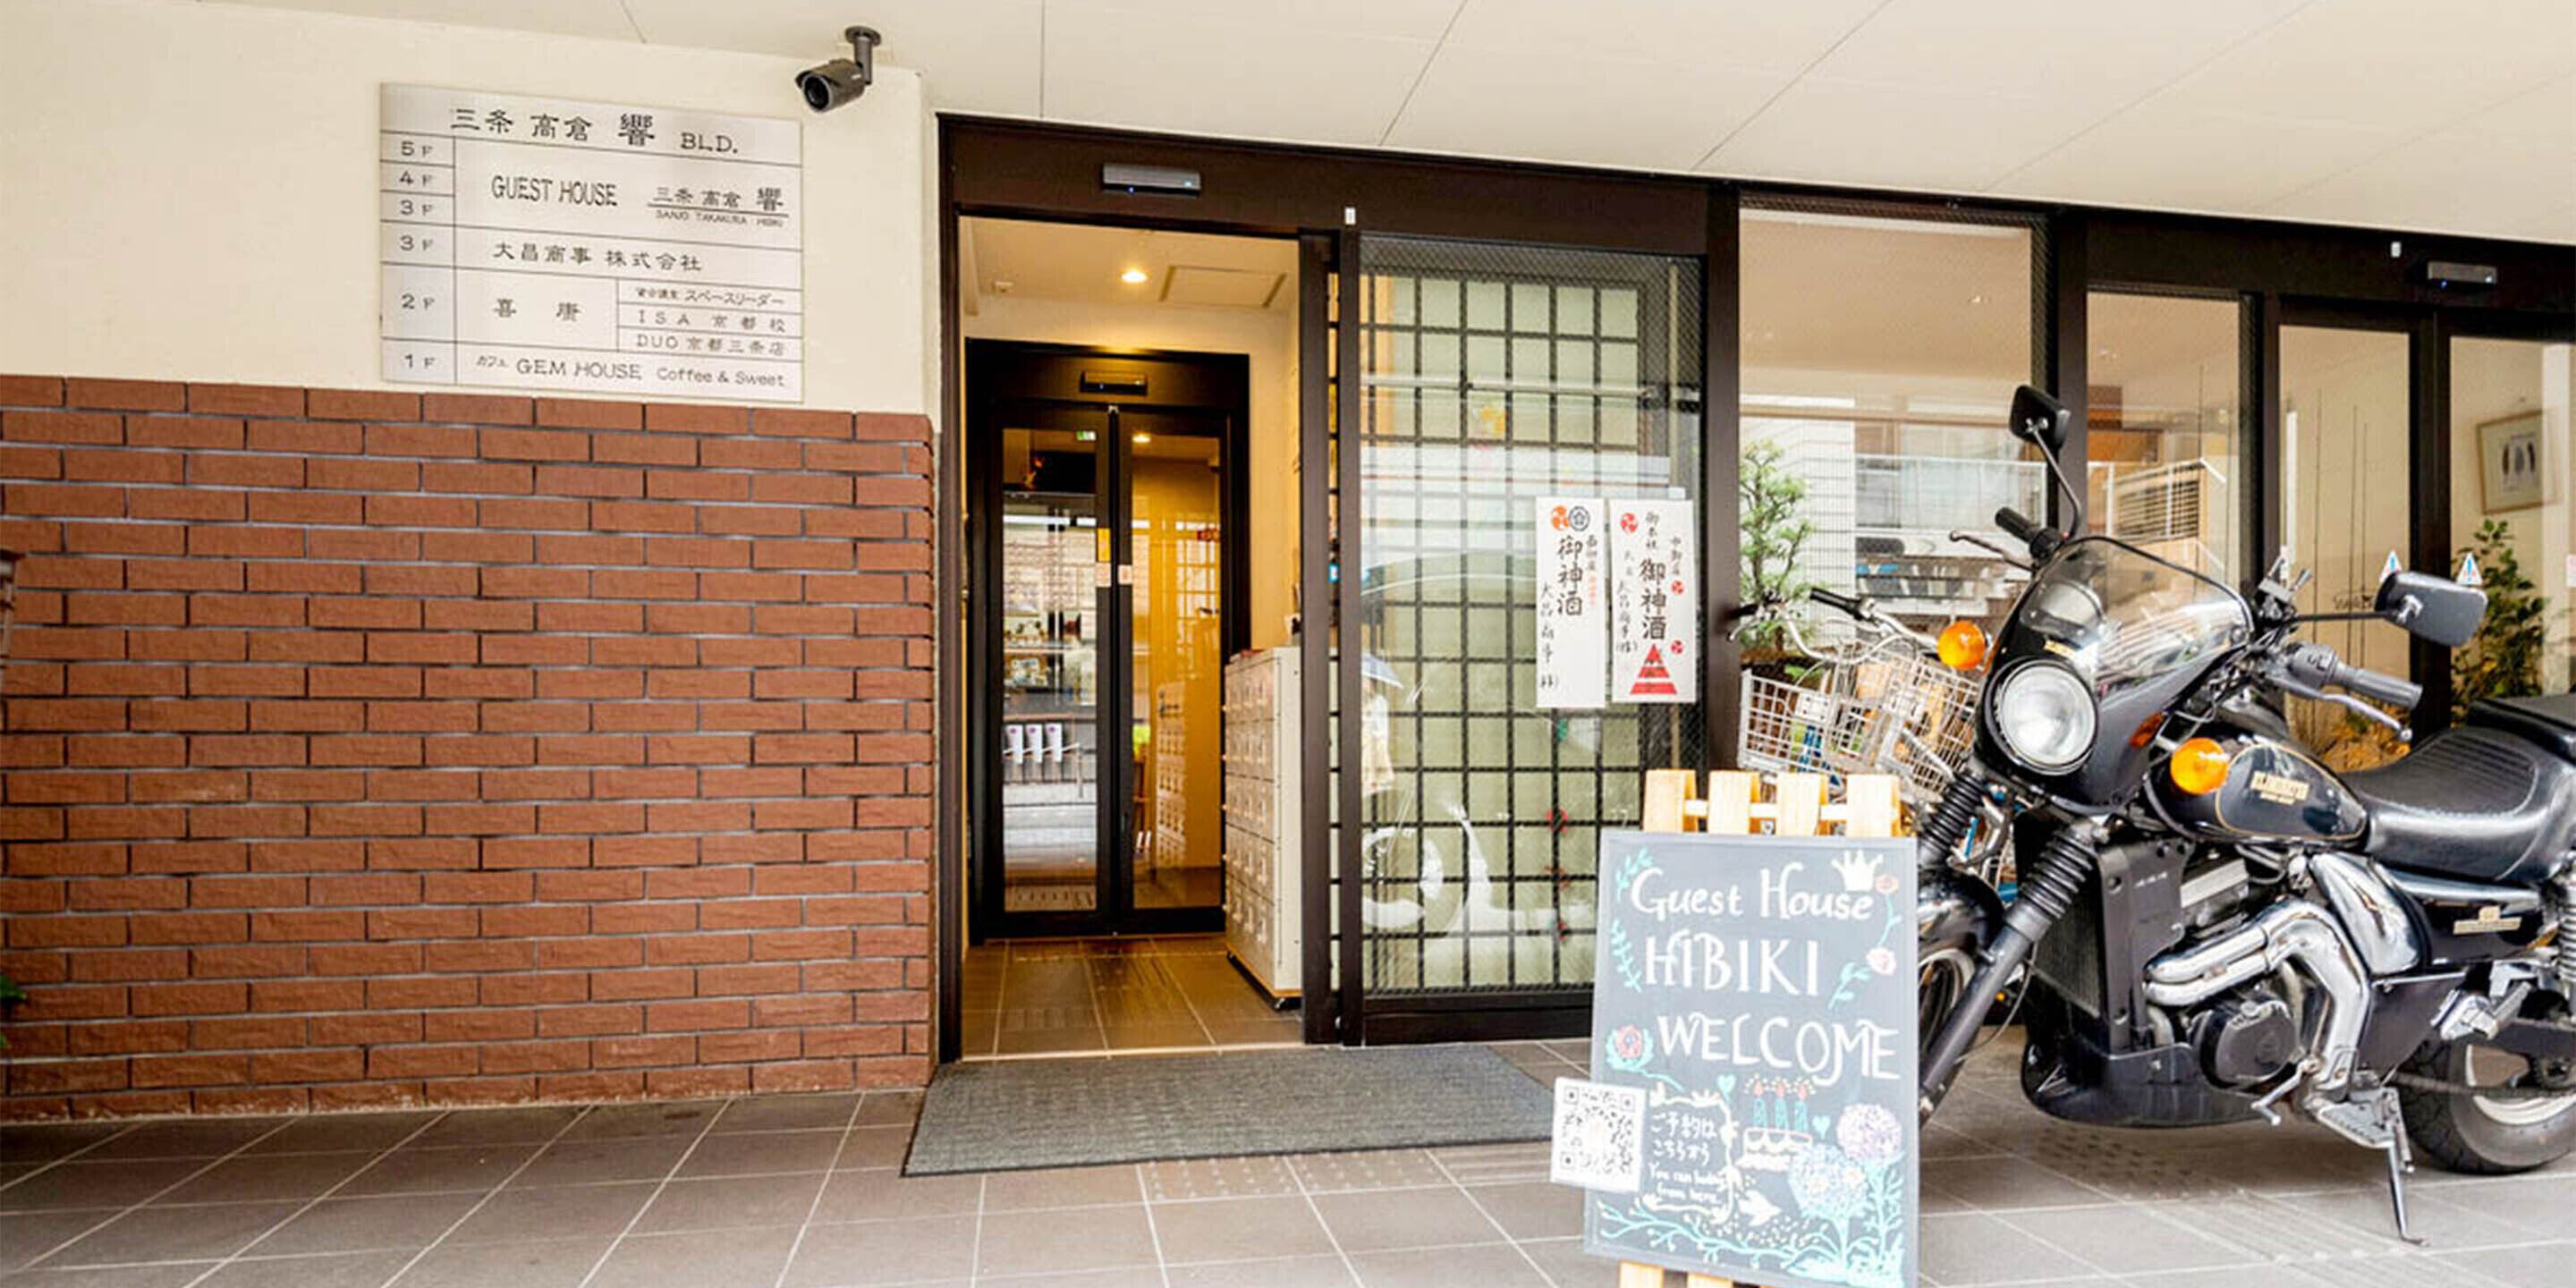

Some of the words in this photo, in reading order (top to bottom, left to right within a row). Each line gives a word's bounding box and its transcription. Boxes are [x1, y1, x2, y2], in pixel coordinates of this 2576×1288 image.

[450, 107, 513, 134] 三条
[530, 113, 593, 141] 高倉
[617, 113, 656, 148] 響
[680, 131, 739, 155] BLD.
[491, 175, 554, 202] GUEST
[559, 180, 618, 207] HOUSE
[756, 187, 784, 211] 響
[491, 242, 592, 265] 大昌商事
[604, 248, 702, 272] 株式会社
[684, 290, 785, 307] スペースリーダー
[638, 309, 691, 326] ISA
[636, 333, 679, 349] DUO
[476, 355, 509, 369] カフェ
[516, 360, 567, 377] GEM
[572, 361, 643, 381] HOUSE
[657, 368, 714, 384] Coffee
[716, 370, 729, 385] &
[734, 371, 786, 388] Sweet
[1557, 534, 1584, 616] 御神酒
[1639, 558, 1667, 640] 御神酒
[1630, 866, 1745, 922] Guest
[1759, 860, 1875, 920] House
[1644, 927, 1819, 997] HIBIKI
[1656, 1012, 1902, 1088] WELCOME
